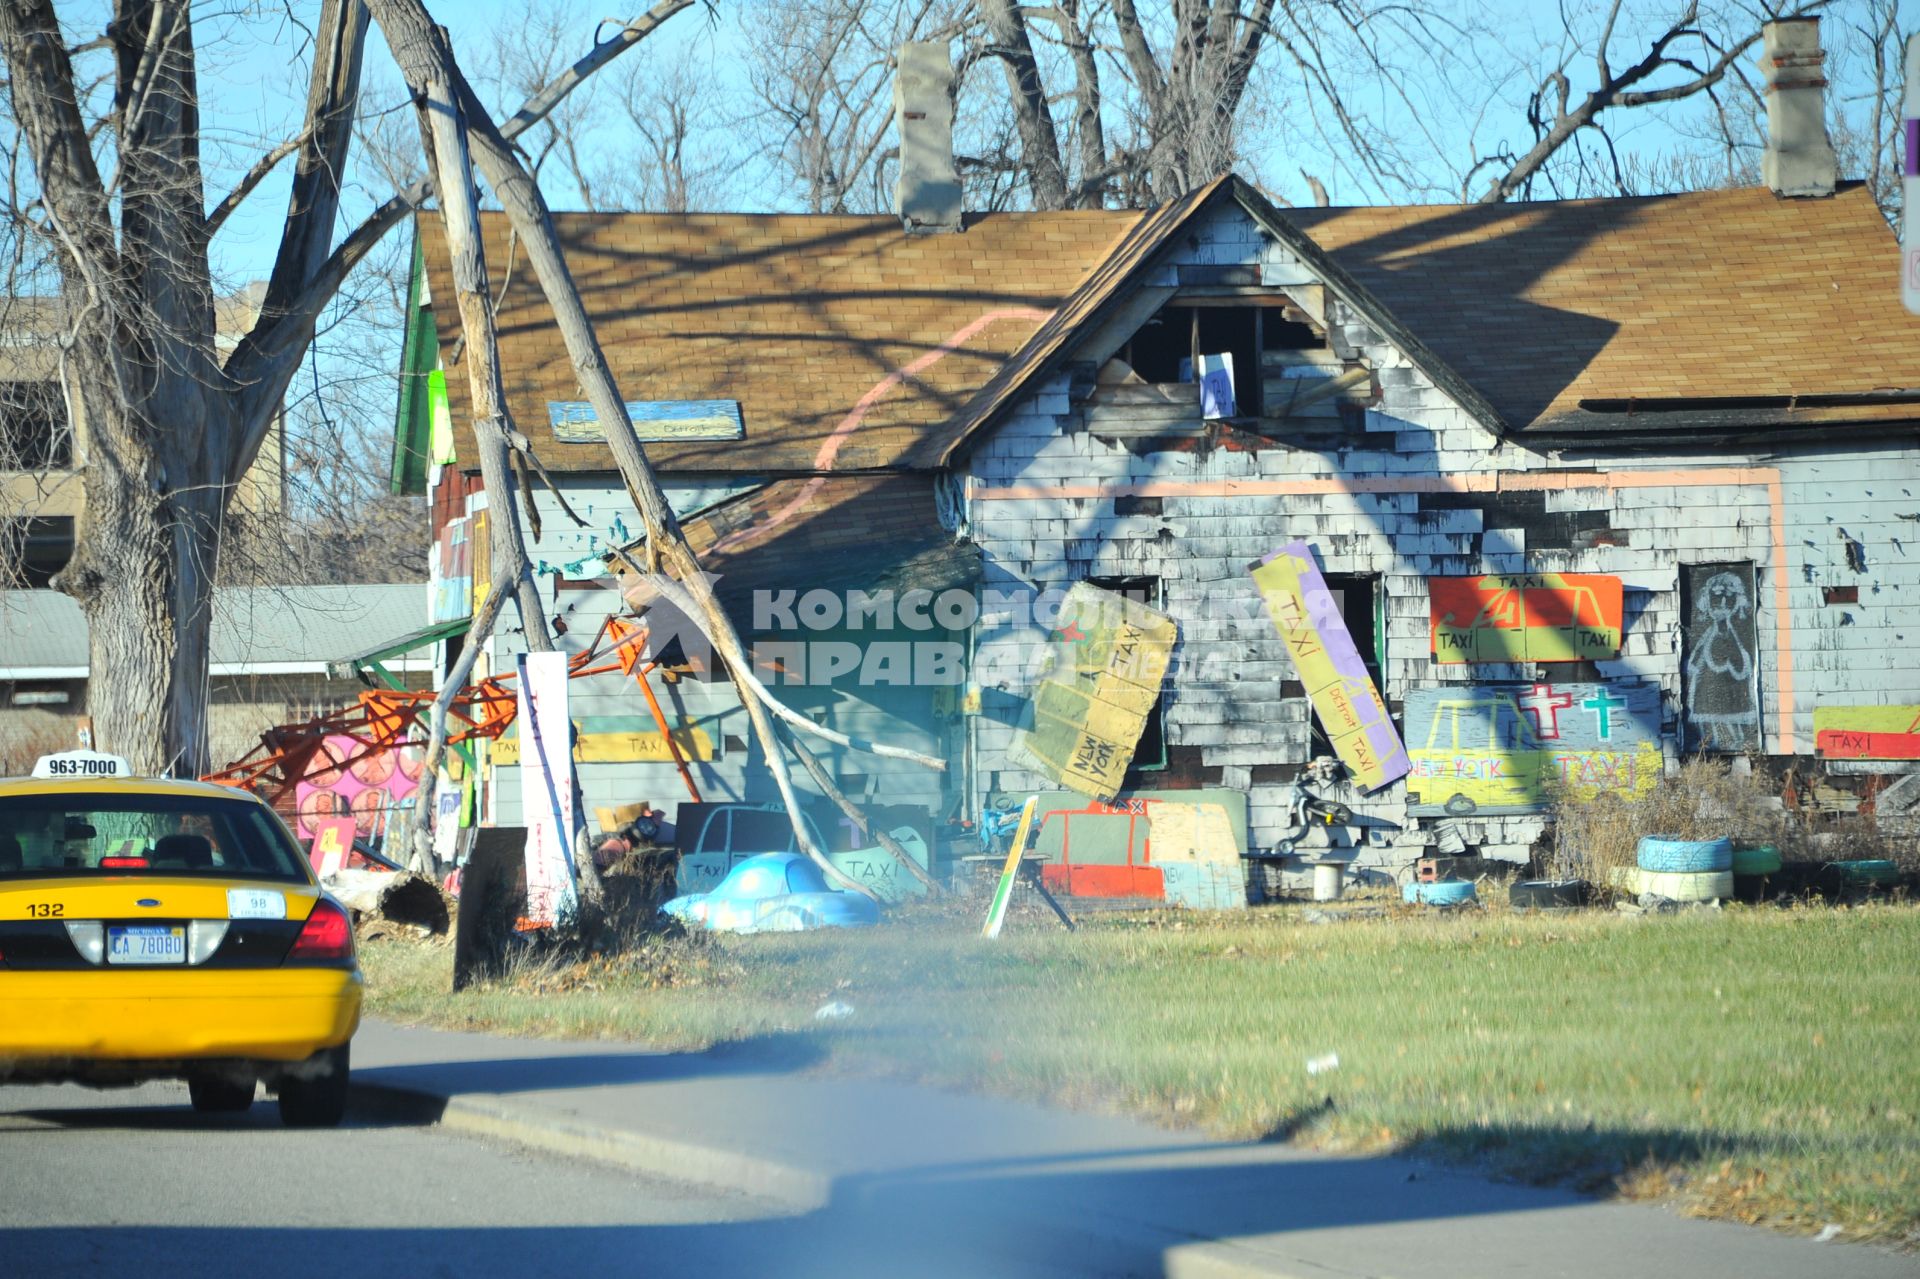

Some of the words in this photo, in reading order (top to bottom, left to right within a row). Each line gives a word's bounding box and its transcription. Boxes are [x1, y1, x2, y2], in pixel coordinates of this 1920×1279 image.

[49, 759, 117, 774] 963-7000
[26, 903, 64, 917] 132
[251, 898, 266, 908] 98
[113, 937, 130, 954] CA
